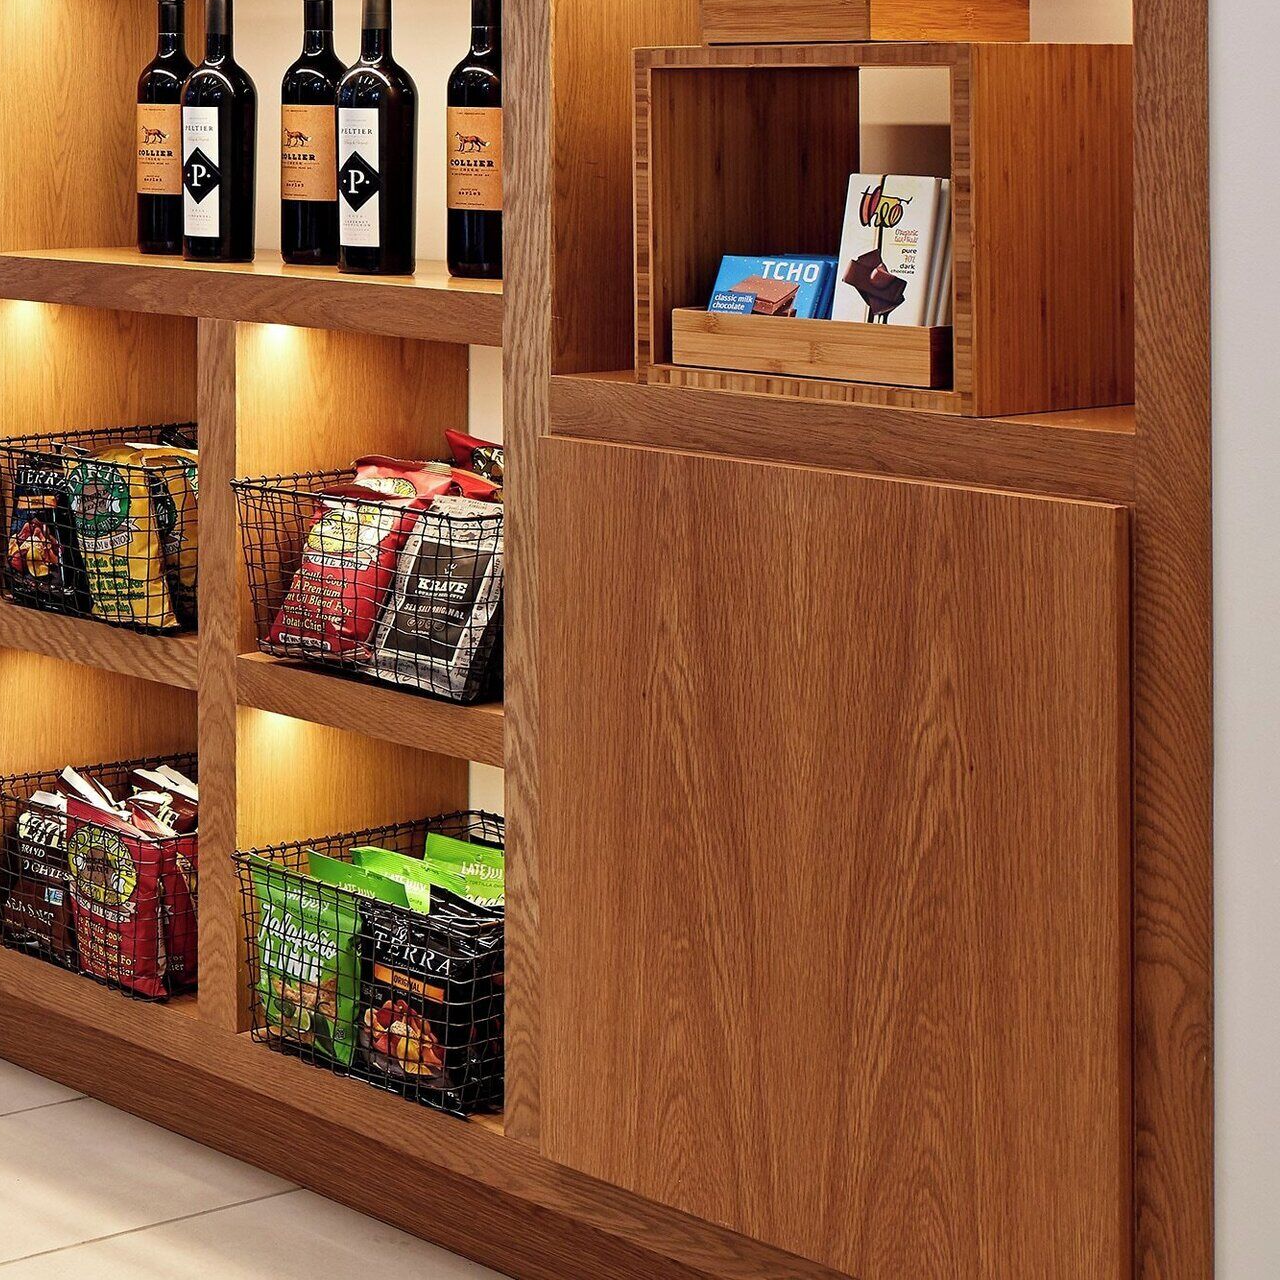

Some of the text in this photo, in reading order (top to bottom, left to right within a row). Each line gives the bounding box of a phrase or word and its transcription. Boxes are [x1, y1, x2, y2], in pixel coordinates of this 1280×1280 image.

[450, 159, 494, 167] COLLIER
[191, 164, 207, 187] P
[348, 169, 365, 194] P
[860, 185, 913, 228] theo
[761, 260, 820, 283] TCHO
[712, 302, 745, 311] chocolate
[714, 292, 753, 303] classic milk
[301, 582, 341, 598] Premium
[418, 578, 468, 595] KRAVE
[307, 594, 332, 607] Blend
[258, 903, 339, 960] Jalapeño
[373, 930, 452, 976] TERRA
